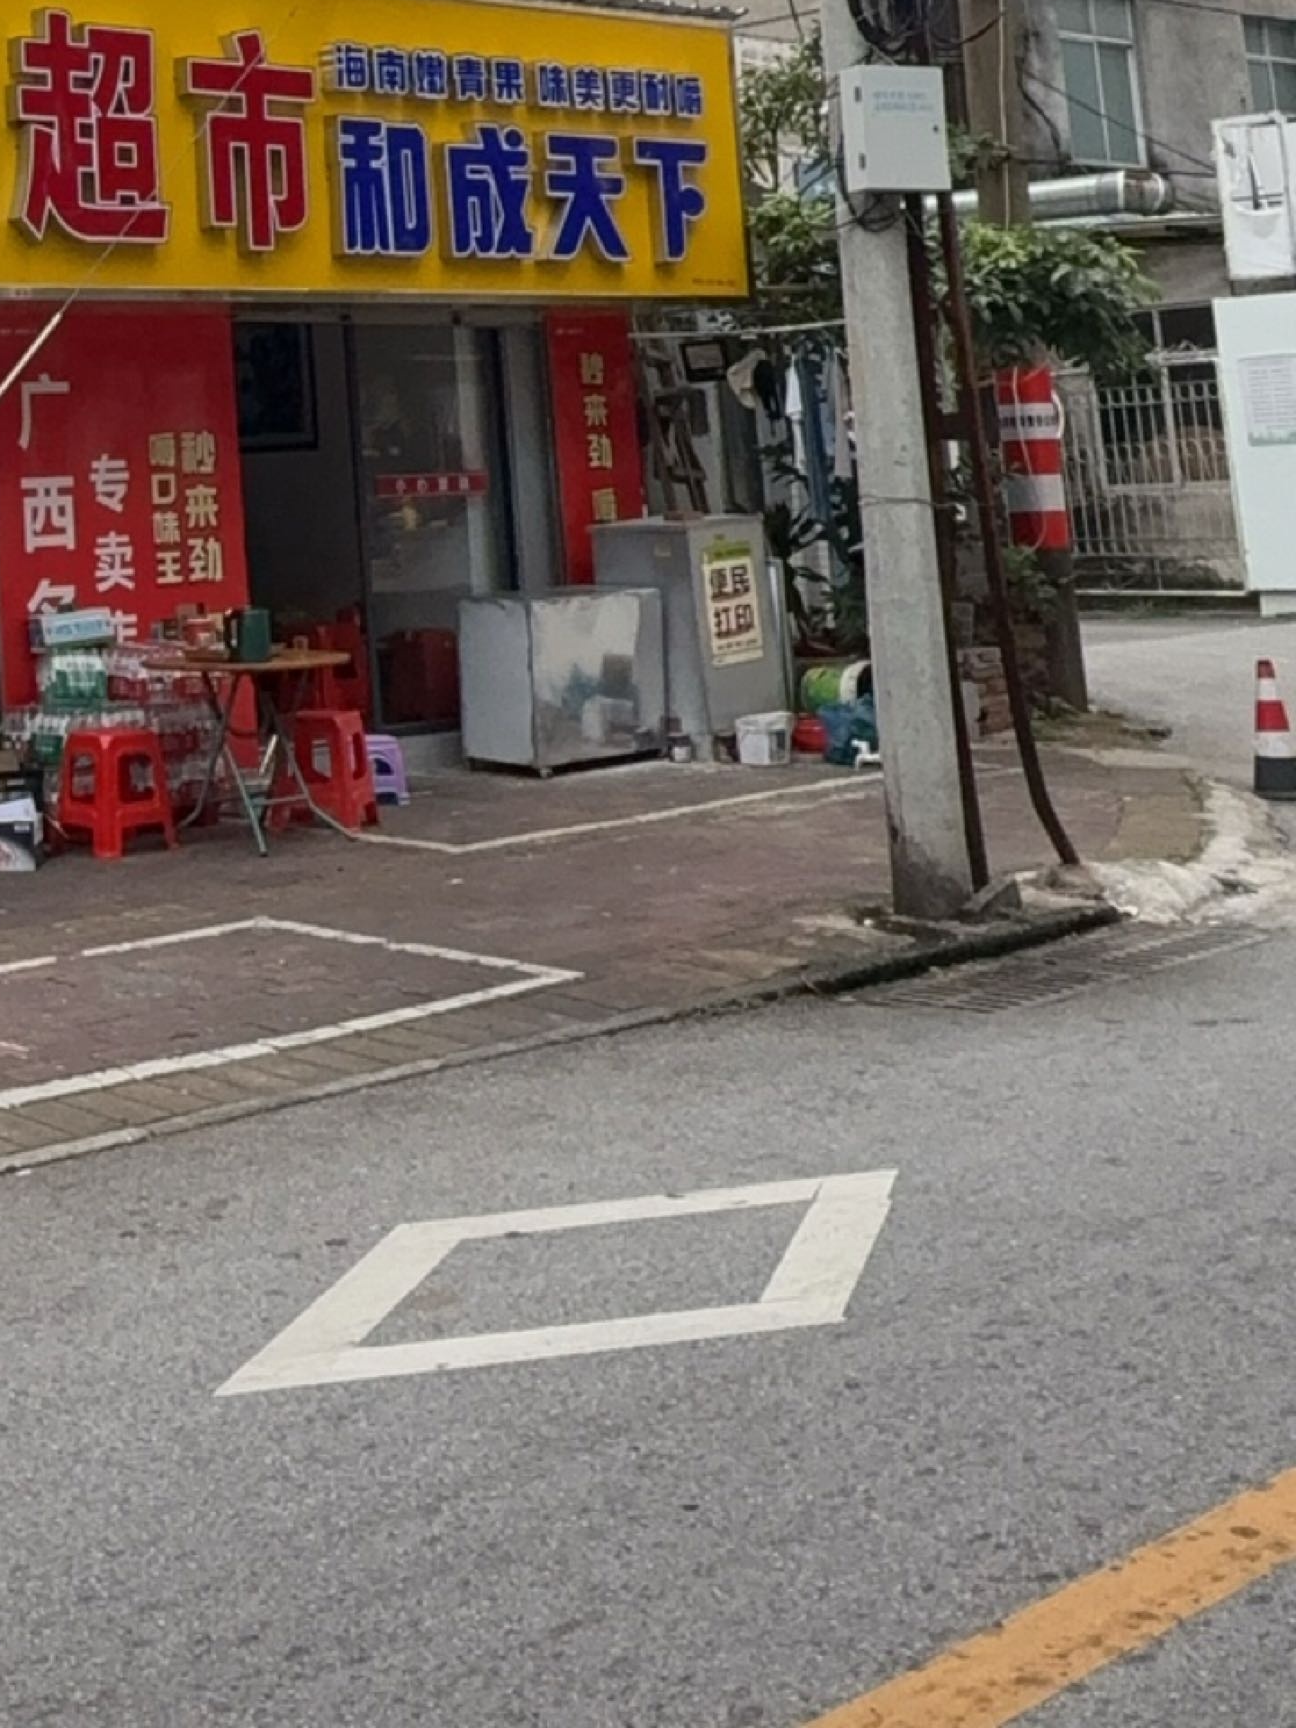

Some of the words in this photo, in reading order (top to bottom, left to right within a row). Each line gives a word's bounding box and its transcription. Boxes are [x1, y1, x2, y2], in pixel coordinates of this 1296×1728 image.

[338, 115, 708, 262] 和成天下
[180, 430, 223, 583] 秒来劲
[710, 565, 751, 599] 便民
[713, 603, 755, 637] 打印
